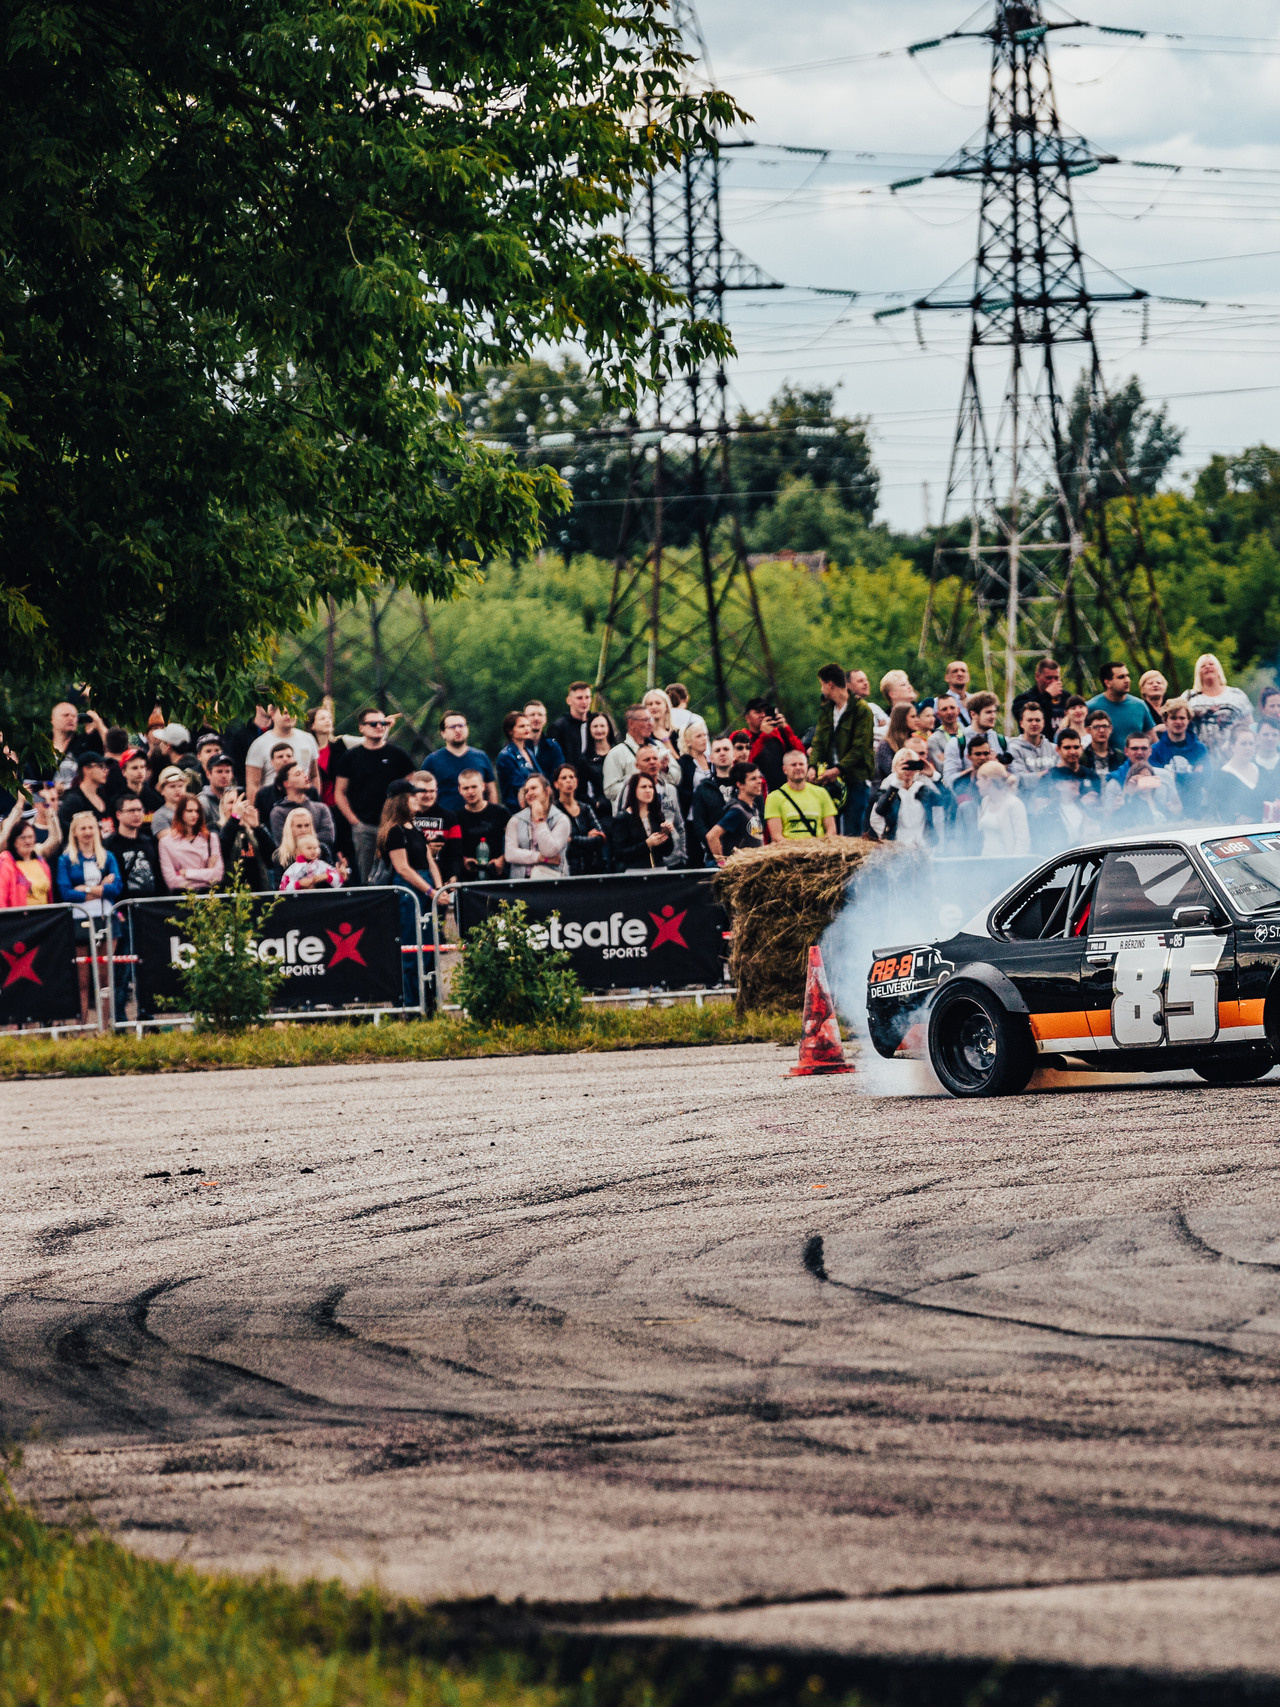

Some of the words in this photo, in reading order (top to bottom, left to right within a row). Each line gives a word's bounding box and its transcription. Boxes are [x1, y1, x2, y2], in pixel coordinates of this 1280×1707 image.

[1220, 841, 1250, 854] LV85
[602, 946, 648, 960] SPORTS
[871, 980, 913, 999] DELIVERY
[1111, 936, 1228, 1049] 85
